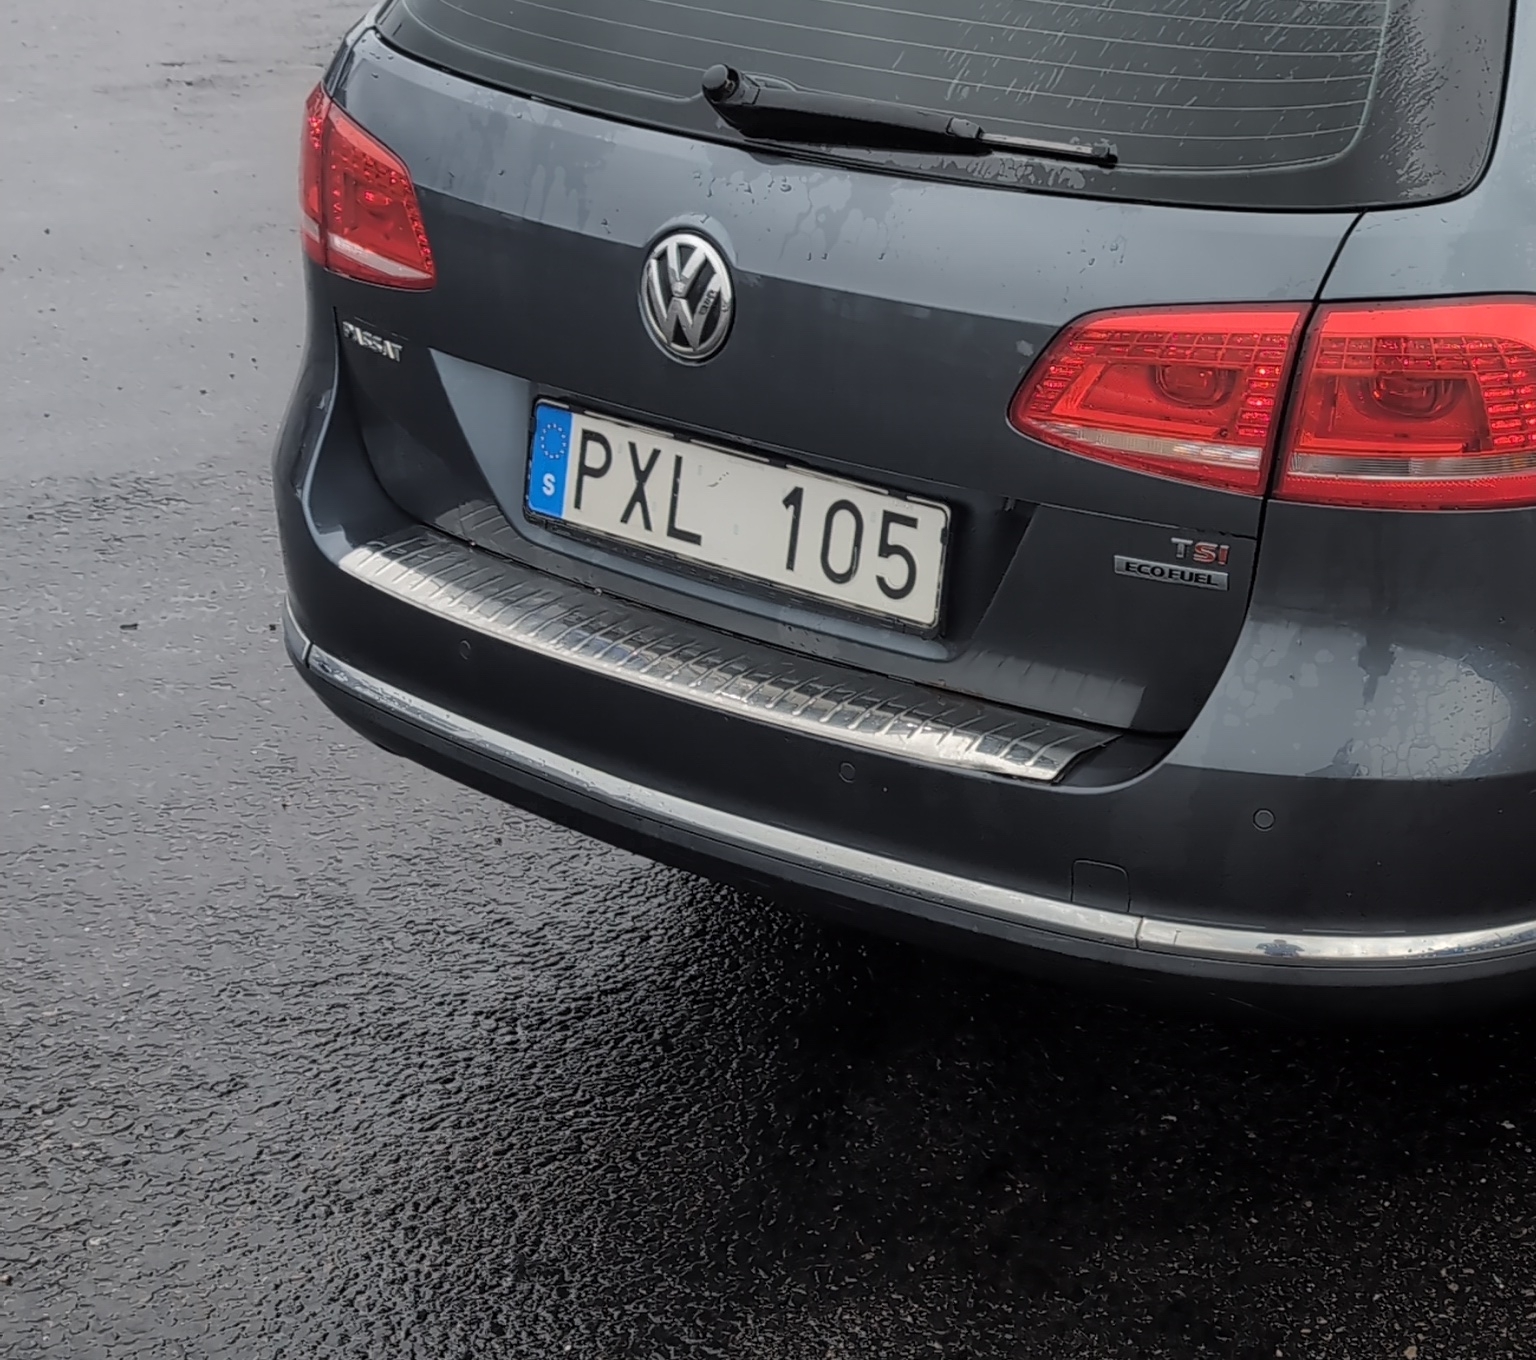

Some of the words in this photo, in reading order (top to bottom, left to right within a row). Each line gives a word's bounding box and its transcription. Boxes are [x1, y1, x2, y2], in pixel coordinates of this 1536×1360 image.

[541, 472, 557, 497] S
[573, 428, 703, 547] PXL
[781, 485, 919, 600] 105
[1170, 537, 1230, 566] TSI
[1123, 561, 1220, 587] ECOFUEL
